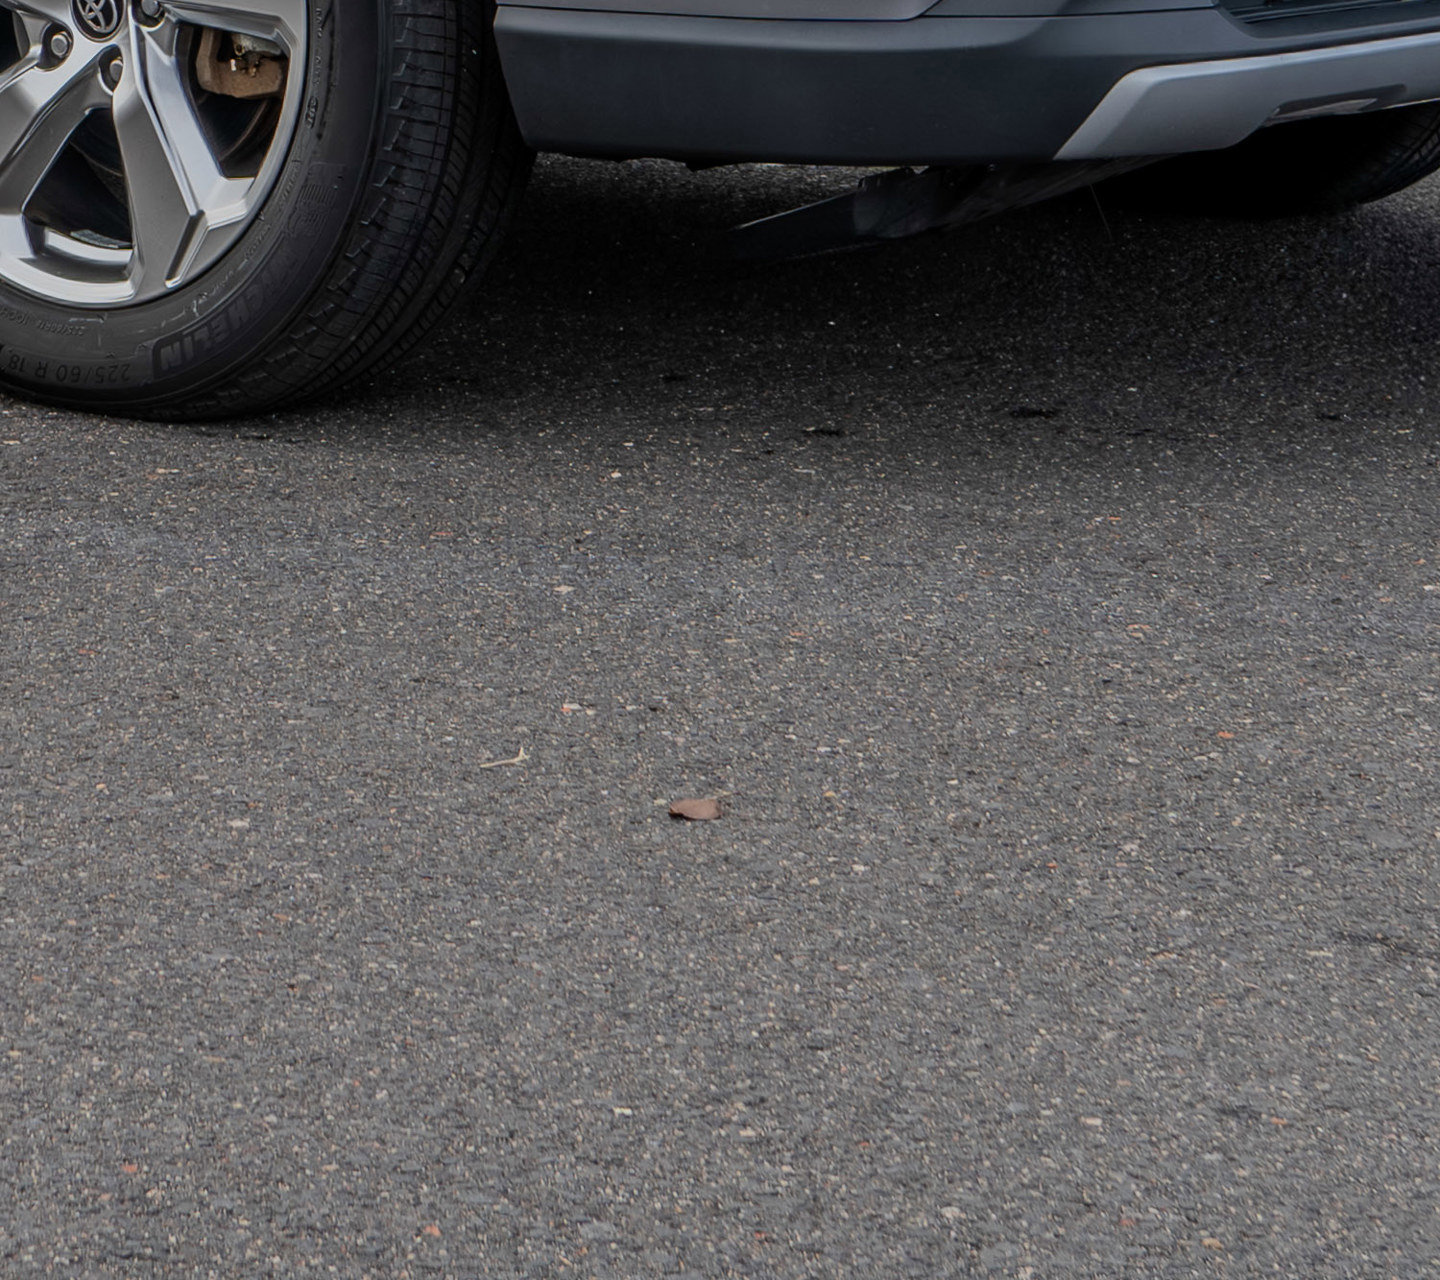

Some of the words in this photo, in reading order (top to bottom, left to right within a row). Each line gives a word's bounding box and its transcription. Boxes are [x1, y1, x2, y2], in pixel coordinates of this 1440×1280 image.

[8, 353, 25, 372] 18
[34, 360, 49, 379] R
[55, 362, 131, 385] 225/60
